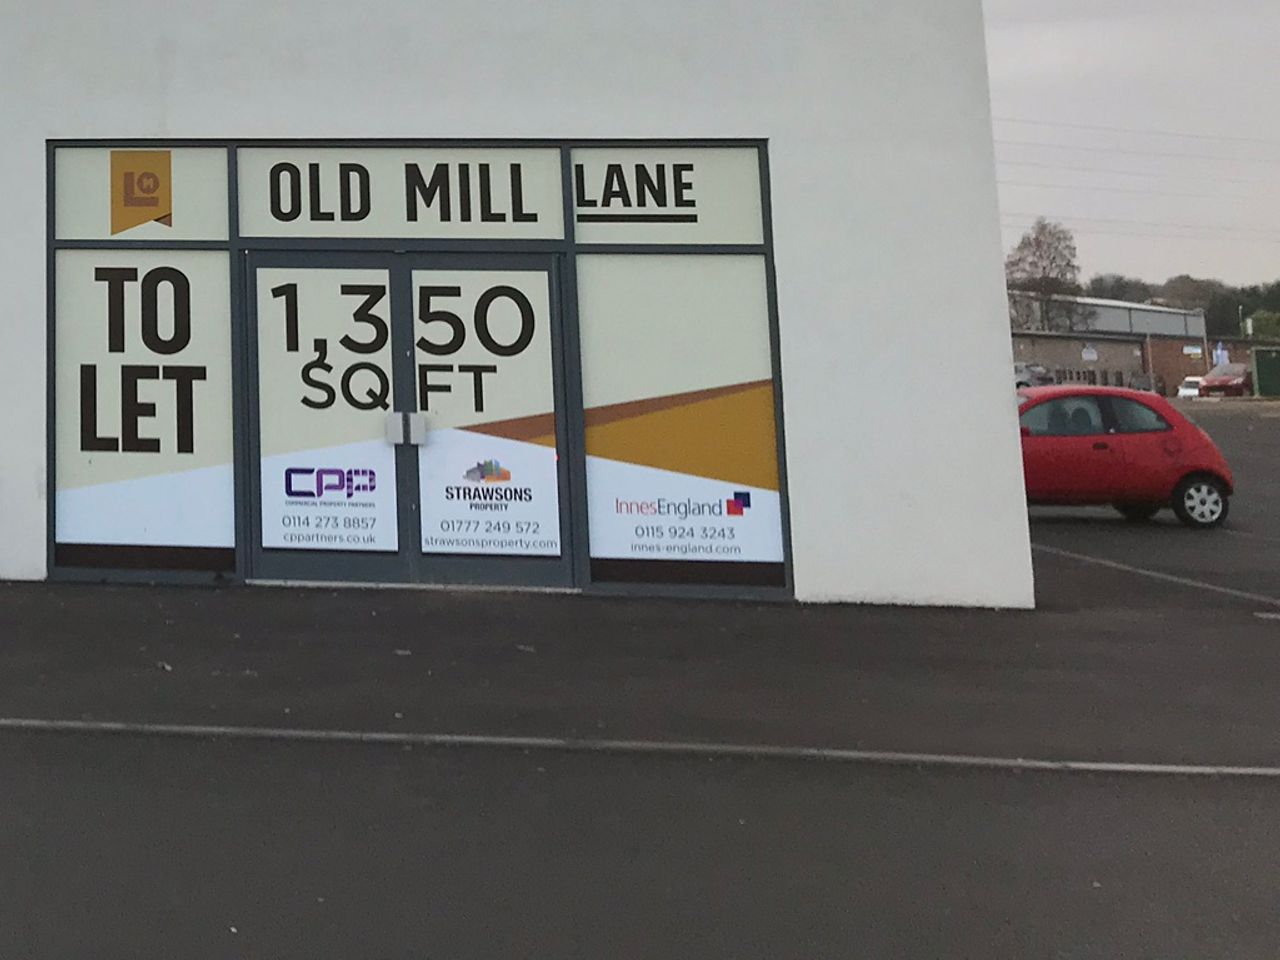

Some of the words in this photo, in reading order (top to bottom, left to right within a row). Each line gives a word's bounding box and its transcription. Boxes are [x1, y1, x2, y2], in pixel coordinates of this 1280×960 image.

[269, 162, 371, 222] OLD
[404, 163, 538, 223] MILL
[574, 163, 697, 208] LANE
[94, 266, 191, 355] TO
[270, 282, 536, 361] 1,350
[300, 359, 390, 411] SQ
[418, 364, 497, 413] FT
[80, 363, 207, 454] LET
[445, 486, 533, 502] STRAWSONS
[469, 502, 509, 512] PROPERTY
[615, 497, 723, 520] InnesEngland
[282, 515, 310, 528] 0114
[315, 516, 339, 529] 273
[343, 516, 377, 530] 8857
[440, 519, 480, 533] 01777
[484, 520, 511, 534] 249
[515, 521, 540, 535] 572
[283, 532, 376, 544] cppartners.co.uk
[634, 525, 664, 539] 0115
[668, 526, 695, 539] 924
[700, 527, 736, 540] 3243
[424, 536, 558, 549] strawsonsproperty.com
[630, 543, 742, 555] innes-england.com
